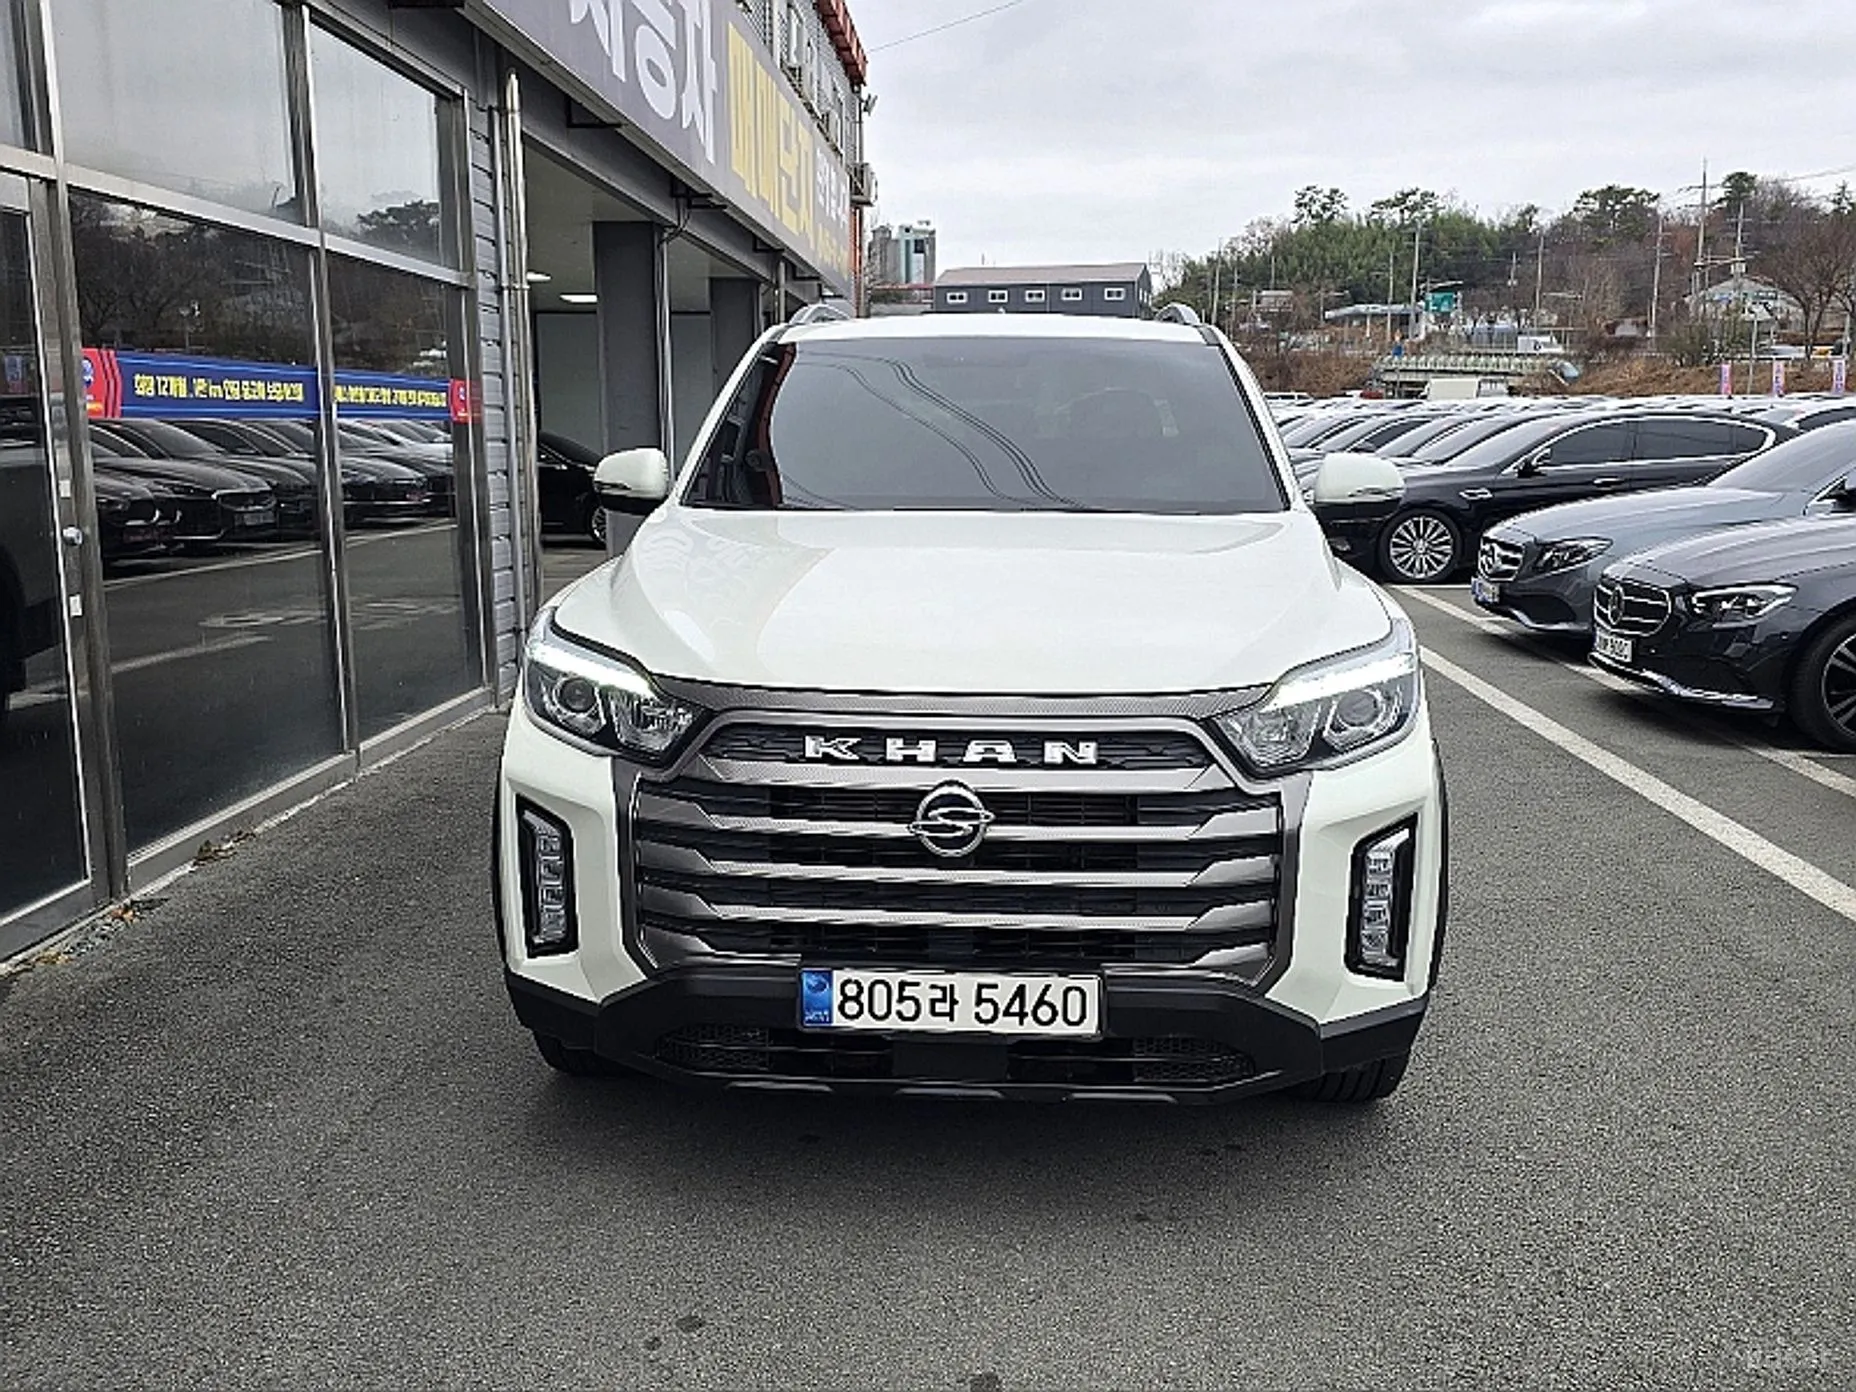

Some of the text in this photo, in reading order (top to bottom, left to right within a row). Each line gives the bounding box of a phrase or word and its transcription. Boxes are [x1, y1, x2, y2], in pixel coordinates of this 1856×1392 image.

[804, 735, 1098, 764] KHAN
[838, 978, 1087, 1027] 805라 5460
